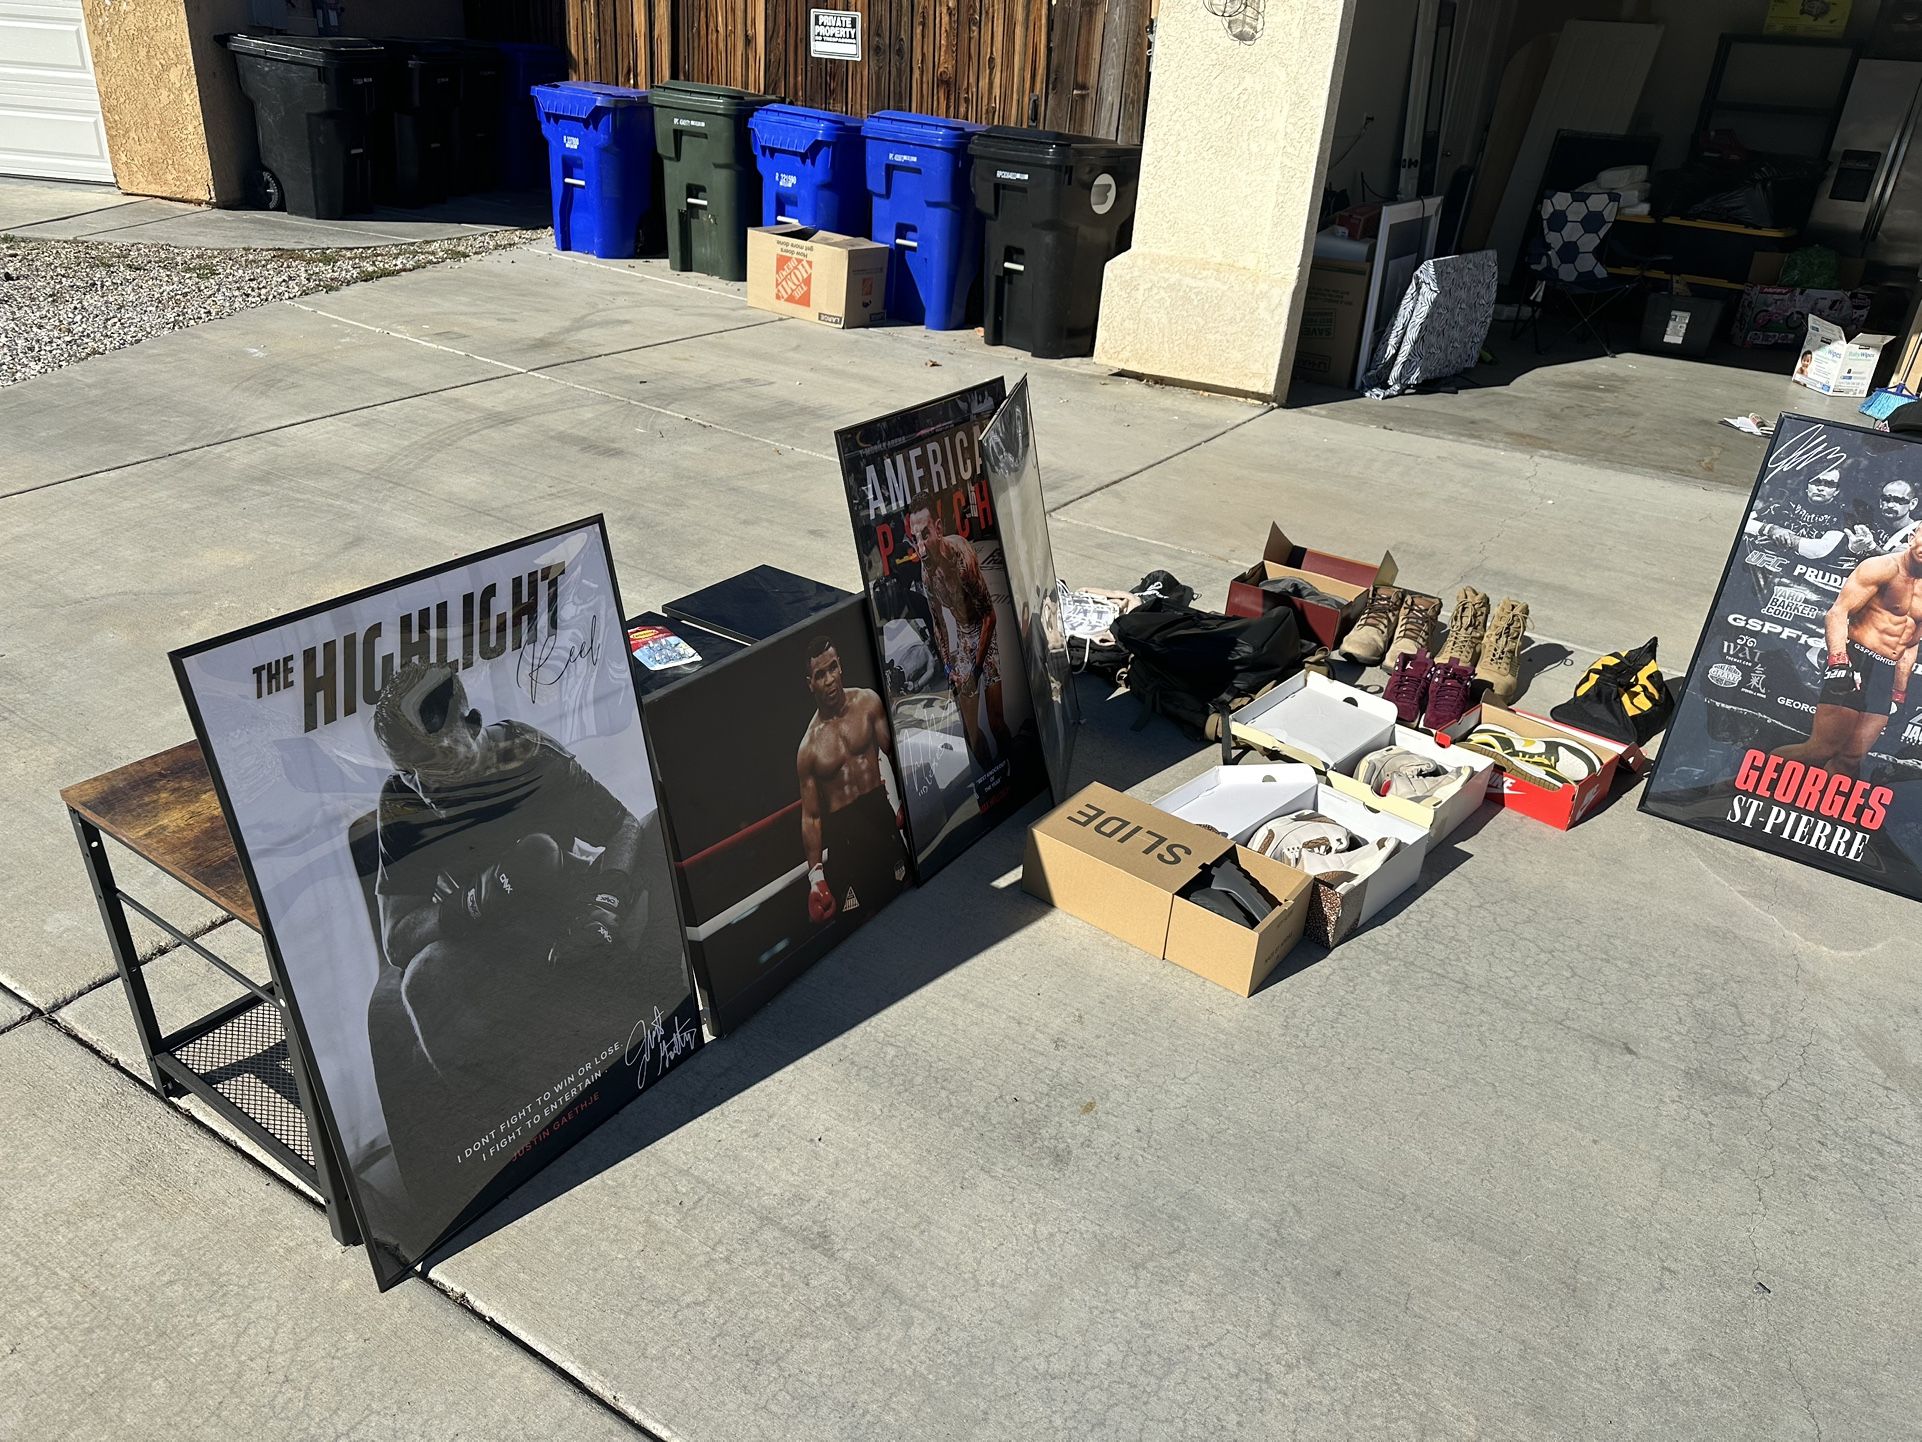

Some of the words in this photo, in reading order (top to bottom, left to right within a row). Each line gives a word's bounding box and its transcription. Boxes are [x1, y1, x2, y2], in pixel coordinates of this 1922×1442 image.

[814, 25, 856, 39] PROPERTY
[818, 15, 852, 28] PRIVATE
[775, 257, 799, 283] DEPOT
[775, 259, 812, 302] HOME
[791, 283, 808, 300] THE
[1745, 550, 1788, 573] UFC
[1769, 597, 1818, 619] BARKER
[1775, 587, 1805, 603] YARD
[1761, 606, 1794, 621] .com
[302, 560, 566, 733] HIGHLIGHT
[252, 654, 294, 699] THE
[1823, 669, 1847, 680] UFC
[1734, 748, 1894, 831] GEORGES
[1066, 803, 1192, 865] SLIDE
[1726, 794, 1870, 862] ST-PIERRE
[456, 1154, 462, 1163] I
[464, 1130, 496, 1158] DONT
[499, 1103, 533, 1133] FIGHT
[535, 1091, 551, 1106] TO
[553, 1074, 575, 1093] WIN
[577, 1062, 592, 1076] OR
[594, 1041, 624, 1065] LOSE.
[489, 1127, 522, 1156] FIGHT
[525, 1114, 541, 1129] TO
[511, 1128, 551, 1162] JUSTIN
[552, 1091, 601, 1131] GAETHJE
